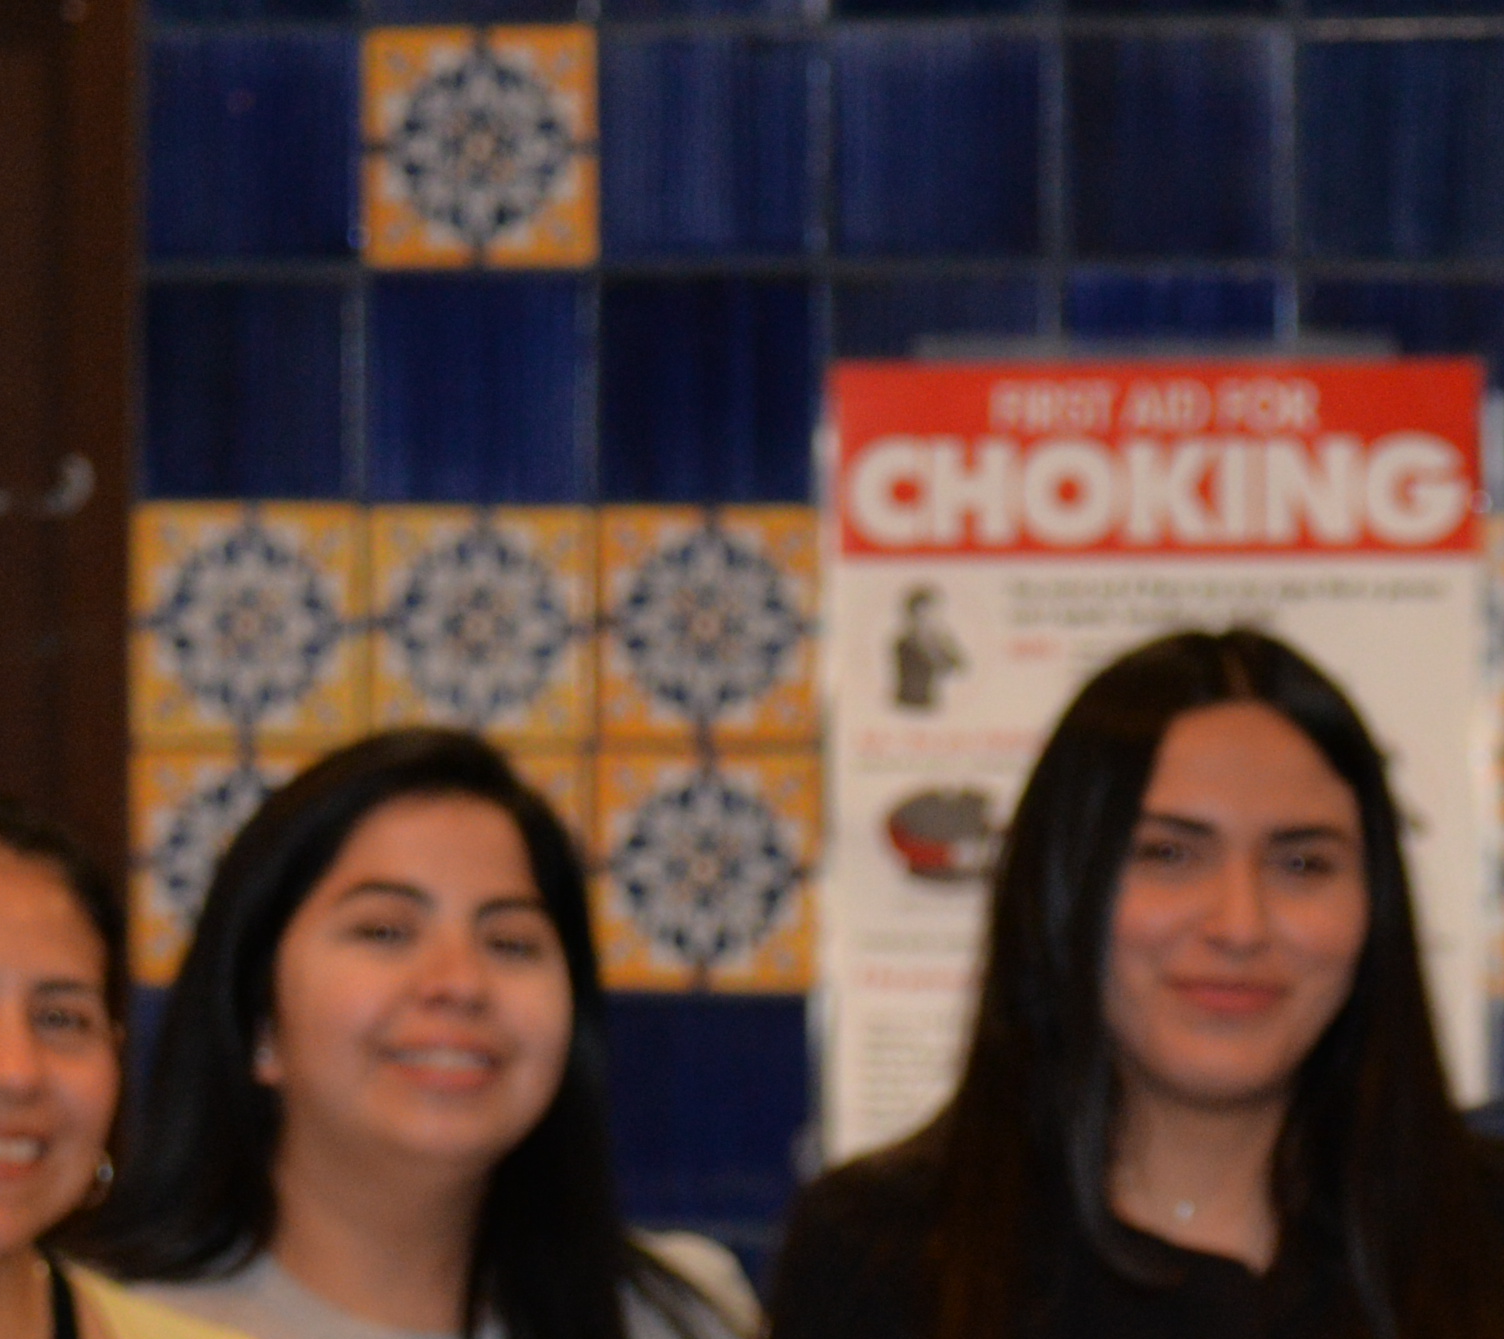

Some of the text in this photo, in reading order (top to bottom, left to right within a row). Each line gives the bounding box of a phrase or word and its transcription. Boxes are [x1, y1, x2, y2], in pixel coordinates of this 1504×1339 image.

[991, 380, 1319, 431] FIRST AID FOR
[849, 433, 1470, 547] CHOKING
